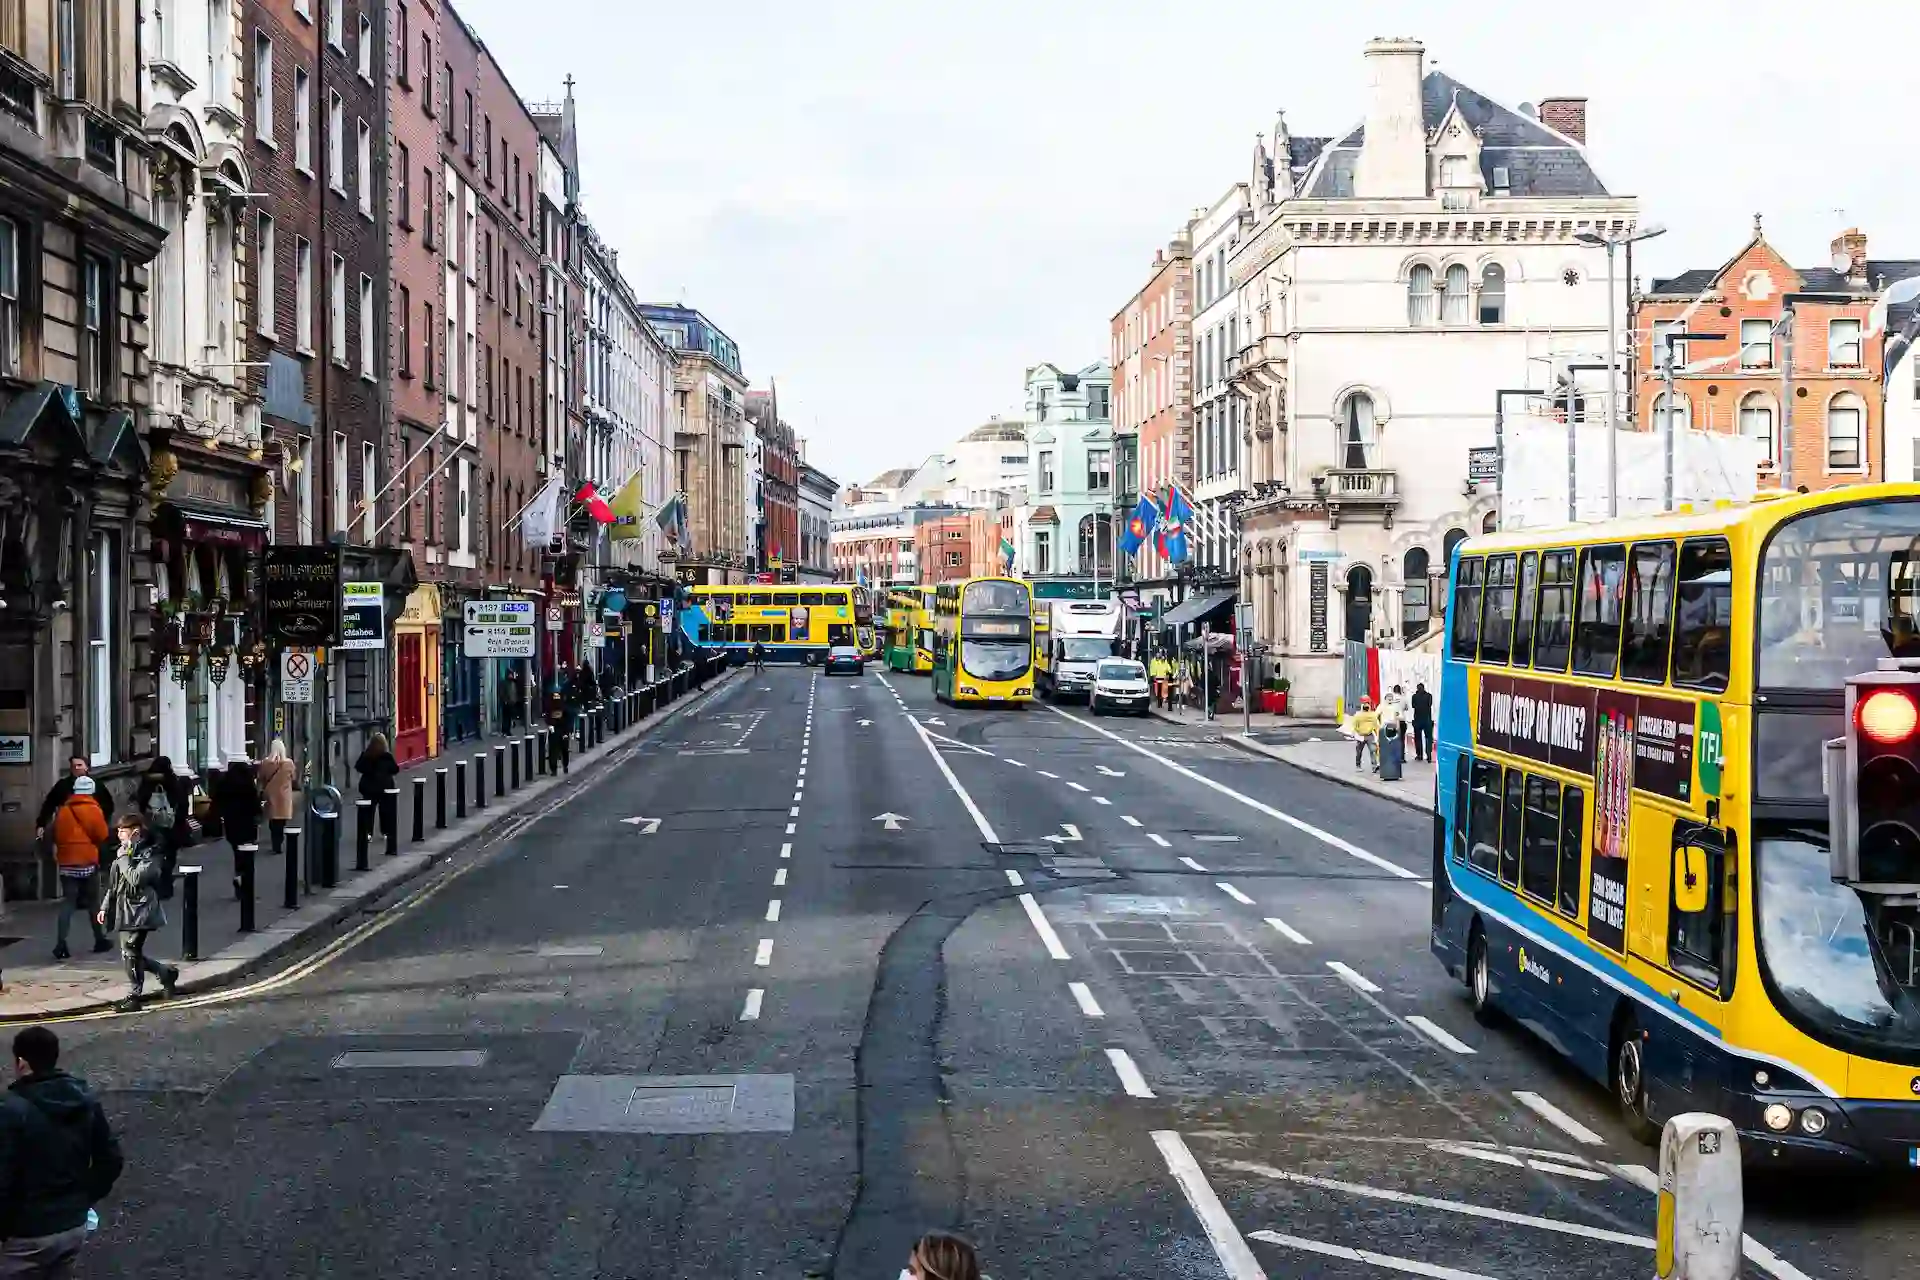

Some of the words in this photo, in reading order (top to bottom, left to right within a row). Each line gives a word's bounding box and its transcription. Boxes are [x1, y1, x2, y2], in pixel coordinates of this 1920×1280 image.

[351, 586, 377, 594] SALE
[487, 646, 529, 654] RATHMINES
[1490, 691, 1511, 734] YOUR
[1511, 695, 1536, 740] STOP
[1536, 699, 1550, 743] OR
[1550, 702, 1586, 752] MINE?
